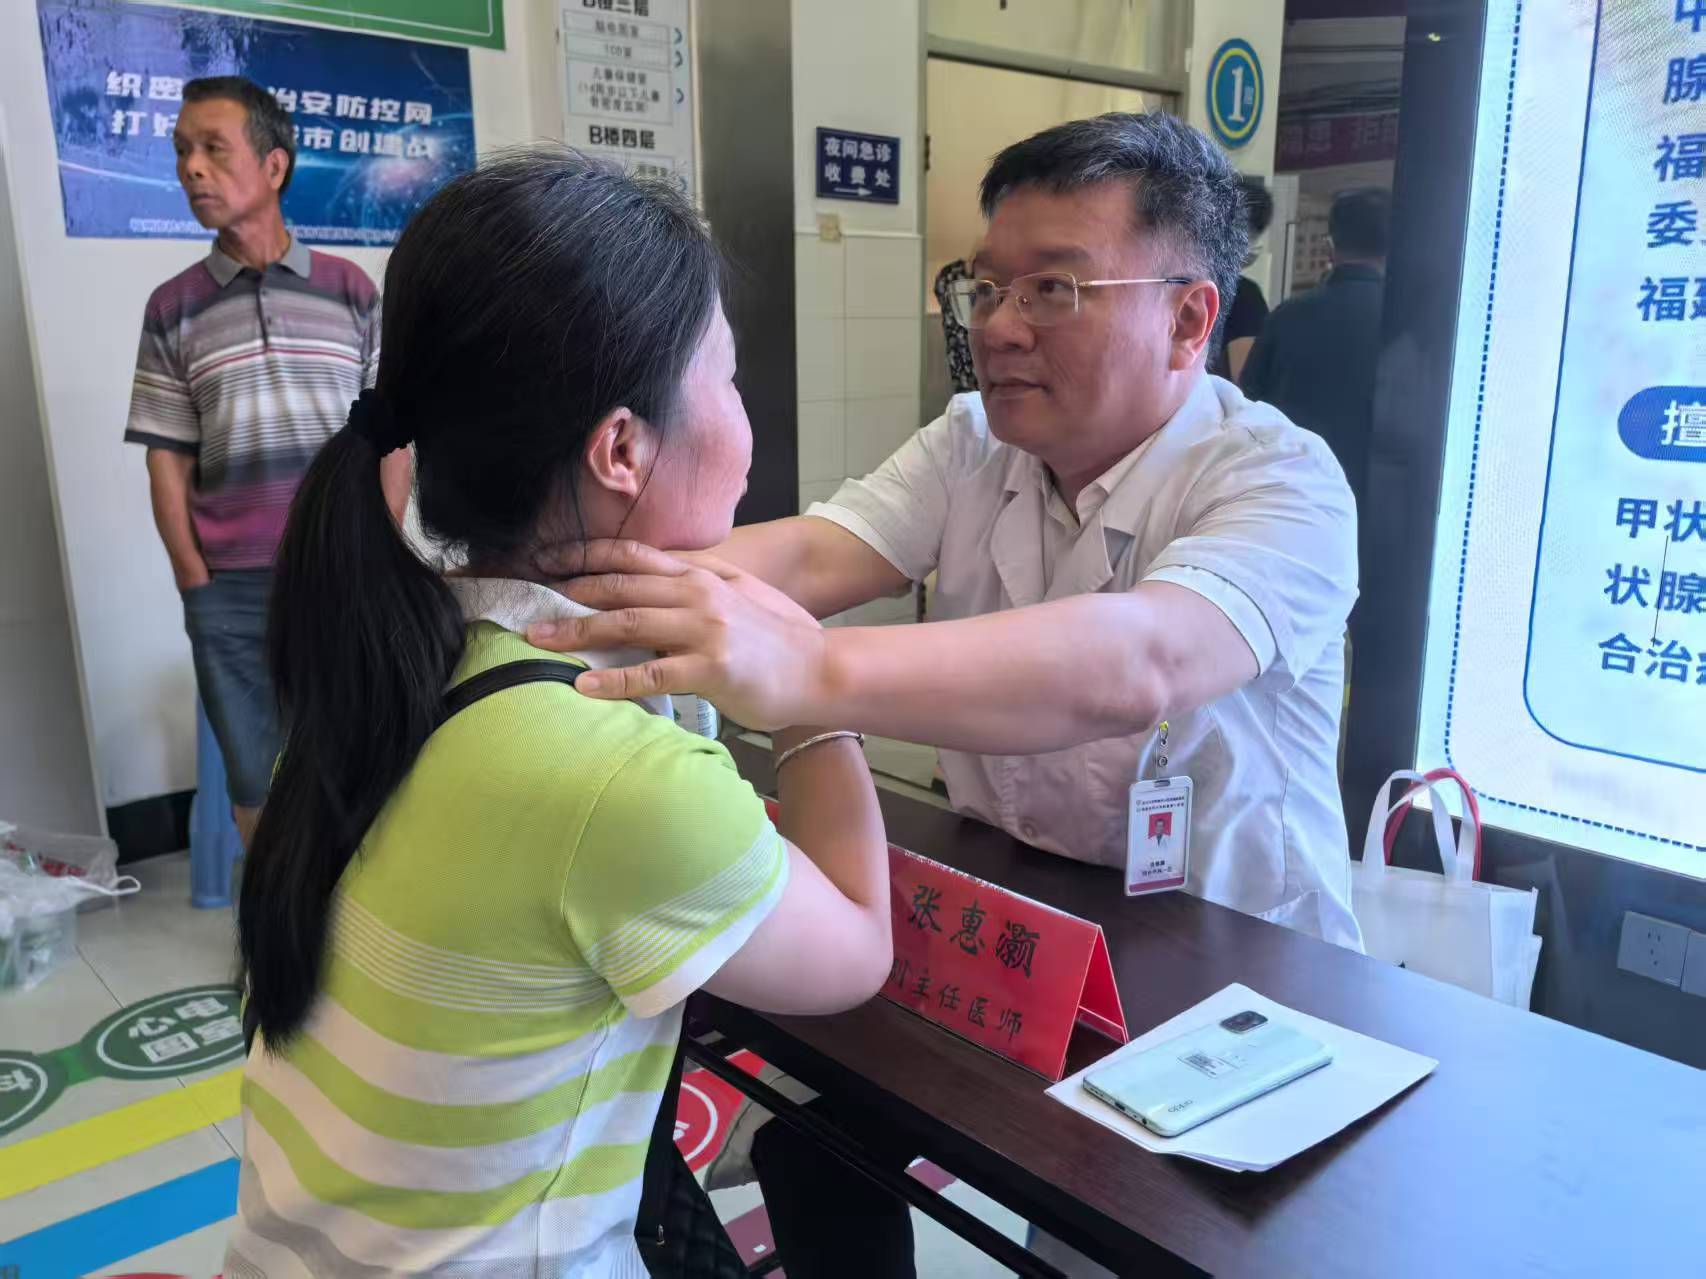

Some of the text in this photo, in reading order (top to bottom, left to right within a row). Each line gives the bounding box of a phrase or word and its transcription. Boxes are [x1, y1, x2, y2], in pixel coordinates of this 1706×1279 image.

[589, 125, 655, 149] B楼四层
[824, 137, 892, 162] 夜间急诊
[824, 162, 891, 188] 收费处
[1646, 200, 1706, 248] 委
[1616, 497, 1706, 543] 甲状
[1603, 562, 1706, 614] 状腺
[1598, 632, 1706, 686] 合治
[908, 884, 1041, 978] 张惠灏
